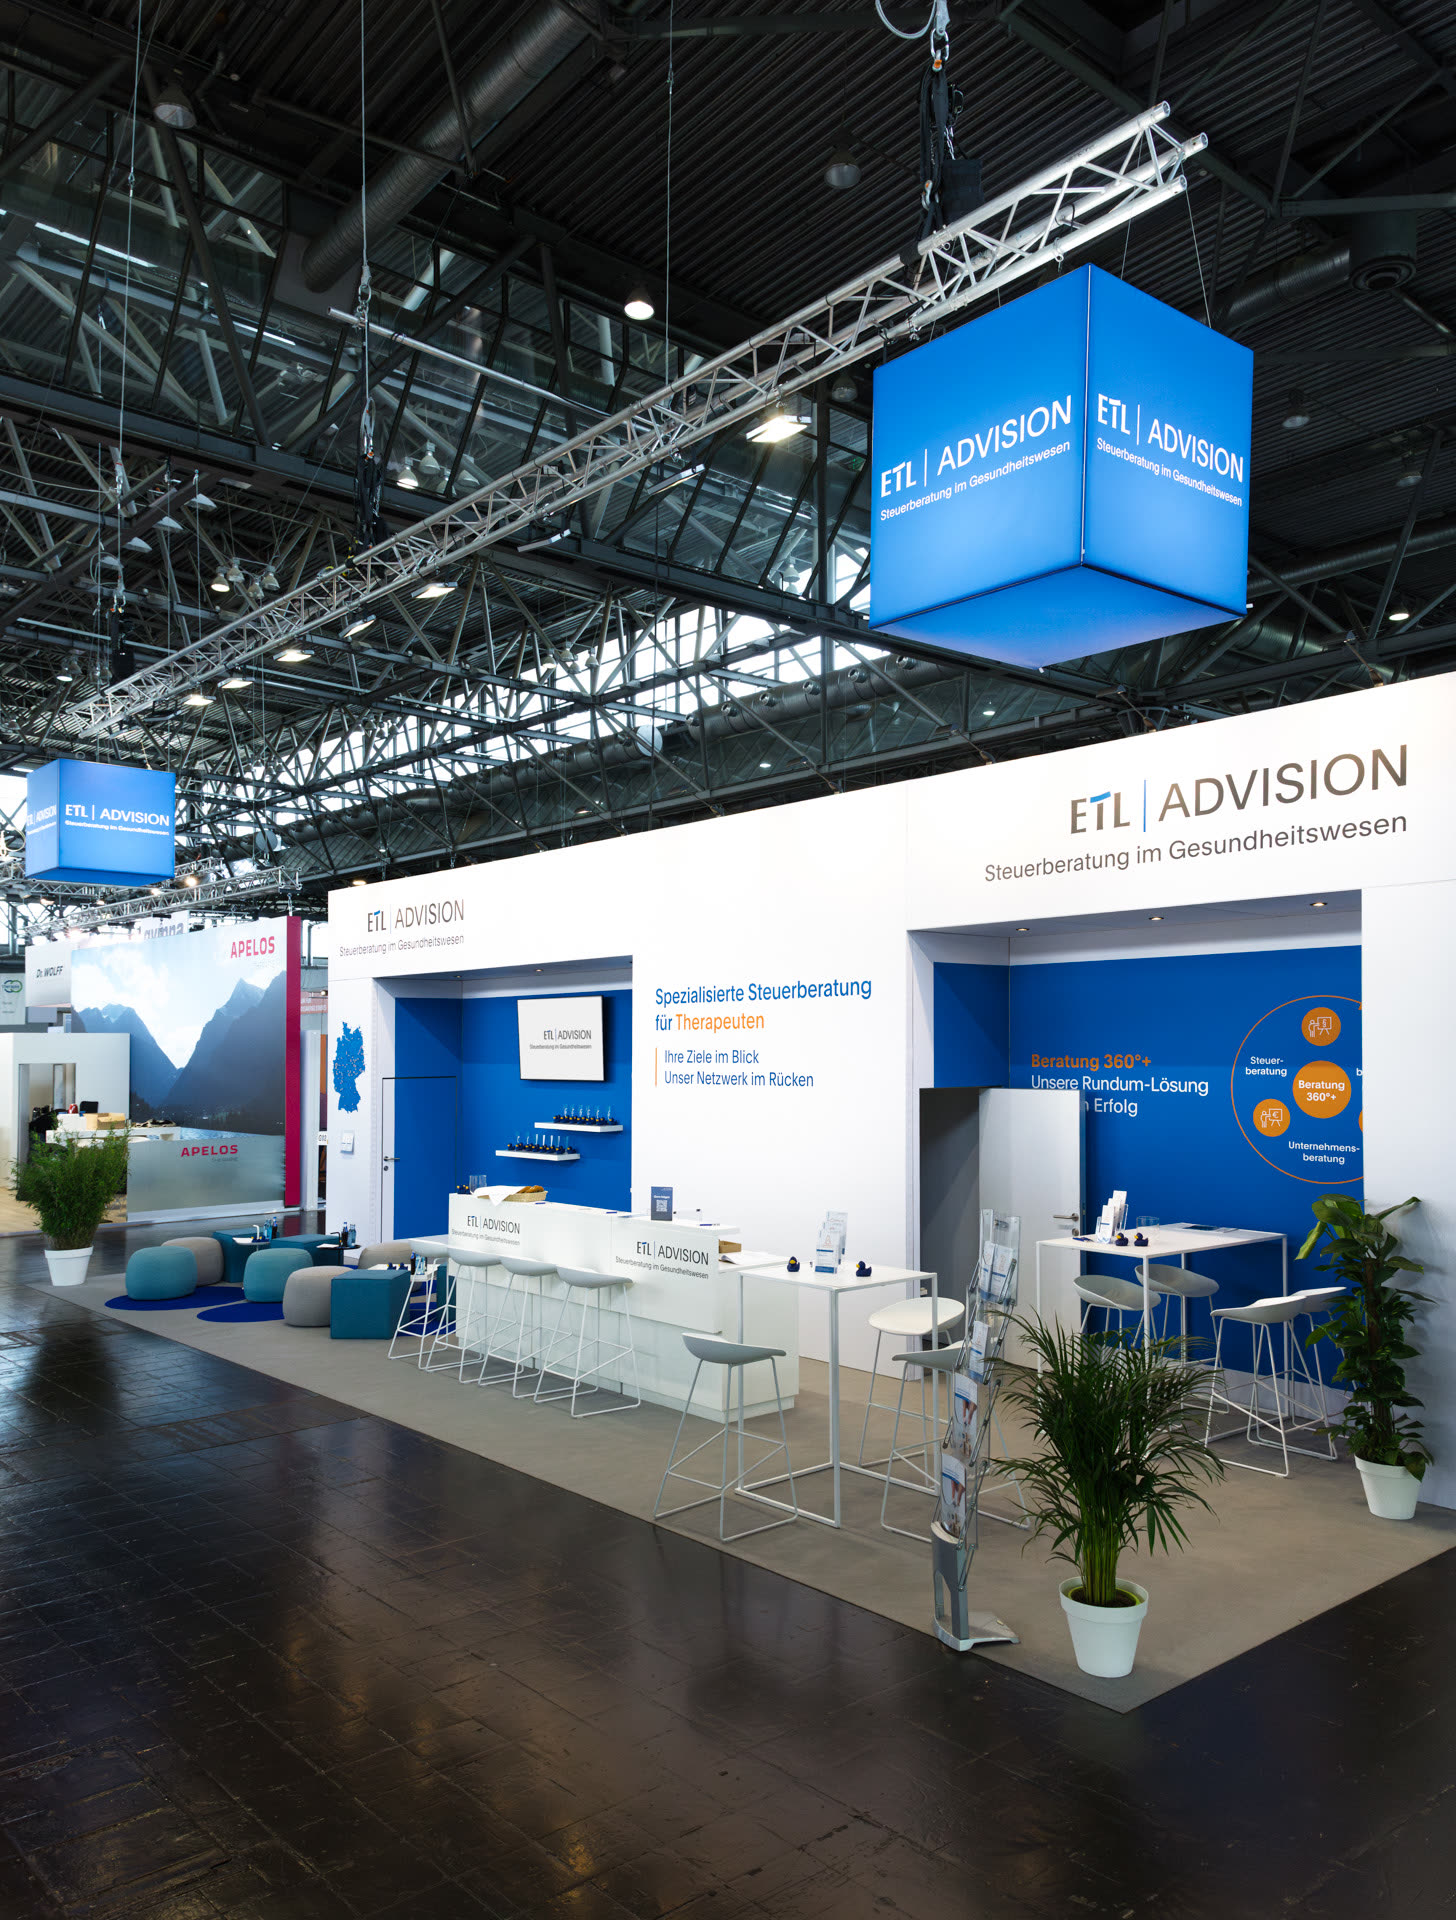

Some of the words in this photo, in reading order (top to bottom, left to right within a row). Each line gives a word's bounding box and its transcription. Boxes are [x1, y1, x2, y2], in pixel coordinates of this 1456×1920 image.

[880, 460, 917, 498] ETL
[937, 395, 1072, 476] ADVISION
[1097, 393, 1131, 436] ETL
[1147, 418, 1244, 483] ADVISION
[880, 485, 952, 521] Steuerberatung
[954, 481, 967, 495] im
[969, 440, 1071, 489] Gesundheitswesen
[1096, 437, 1160, 475] Steuerberatung
[1161, 465, 1172, 479] im
[1172, 468, 1243, 507] Gesundheitswesen
[1071, 791, 1131, 834] ETL
[1158, 744, 1408, 822] ADVISION
[65, 804, 88, 818] ETL
[100, 808, 170, 827] ADVISION
[984, 847, 1130, 882] Steuerberatung
[1136, 846, 1162, 864] im
[1169, 815, 1408, 860] Gesundheitswesen
[367, 910, 387, 932] ETL
[395, 898, 464, 929] ADVISION
[230, 935, 275, 959] APELOS
[339, 943, 387, 957] Steuerberatung
[388, 942, 397, 952] im
[397, 935, 465, 951] Gesundheitswesen
[44, 965, 64, 977] WOLFF
[655, 985, 744, 1008] Spezialisierte
[748, 979, 872, 999] Steuerberatung
[655, 1014, 673, 1031] für
[675, 1013, 765, 1033] Therapeuten
[543, 1029, 554, 1040] ETL
[558, 1029, 592, 1040] ADVISION
[664, 1050, 684, 1064] Ihre
[687, 1050, 712, 1064] Ziele
[715, 1050, 729, 1064] im
[732, 1049, 760, 1064] Blick
[1031, 1053, 1100, 1072] Beratung
[1103, 1053, 1152, 1069] 360°+
[1250, 1055, 1284, 1066] Steuer-
[664, 1070, 694, 1085] Unser
[697, 1070, 748, 1086] Netzwerk
[751, 1072, 766, 1086] im
[769, 1071, 814, 1087] Rücken
[1245, 1066, 1288, 1078] beratung
[1031, 1075, 1079, 1091] Unsere
[1082, 1076, 1209, 1097] Rundum-Lösung
[1298, 1080, 1345, 1092] Beratung
[1094, 1097, 1138, 1118] Erfolg
[1306, 1092, 1337, 1102] 360°+
[180, 1144, 239, 1157] APELOS
[1288, 1141, 1360, 1153] Unternehmens-
[1302, 1153, 1346, 1165] beratung
[467, 1215, 479, 1228] ETL
[483, 1217, 520, 1235] ADVISION
[636, 1241, 652, 1256] ETL
[657, 1245, 709, 1266] ADVISION
[615, 1256, 652, 1270] Steuerberatung
[660, 1263, 709, 1279] Gesundheitswesen
